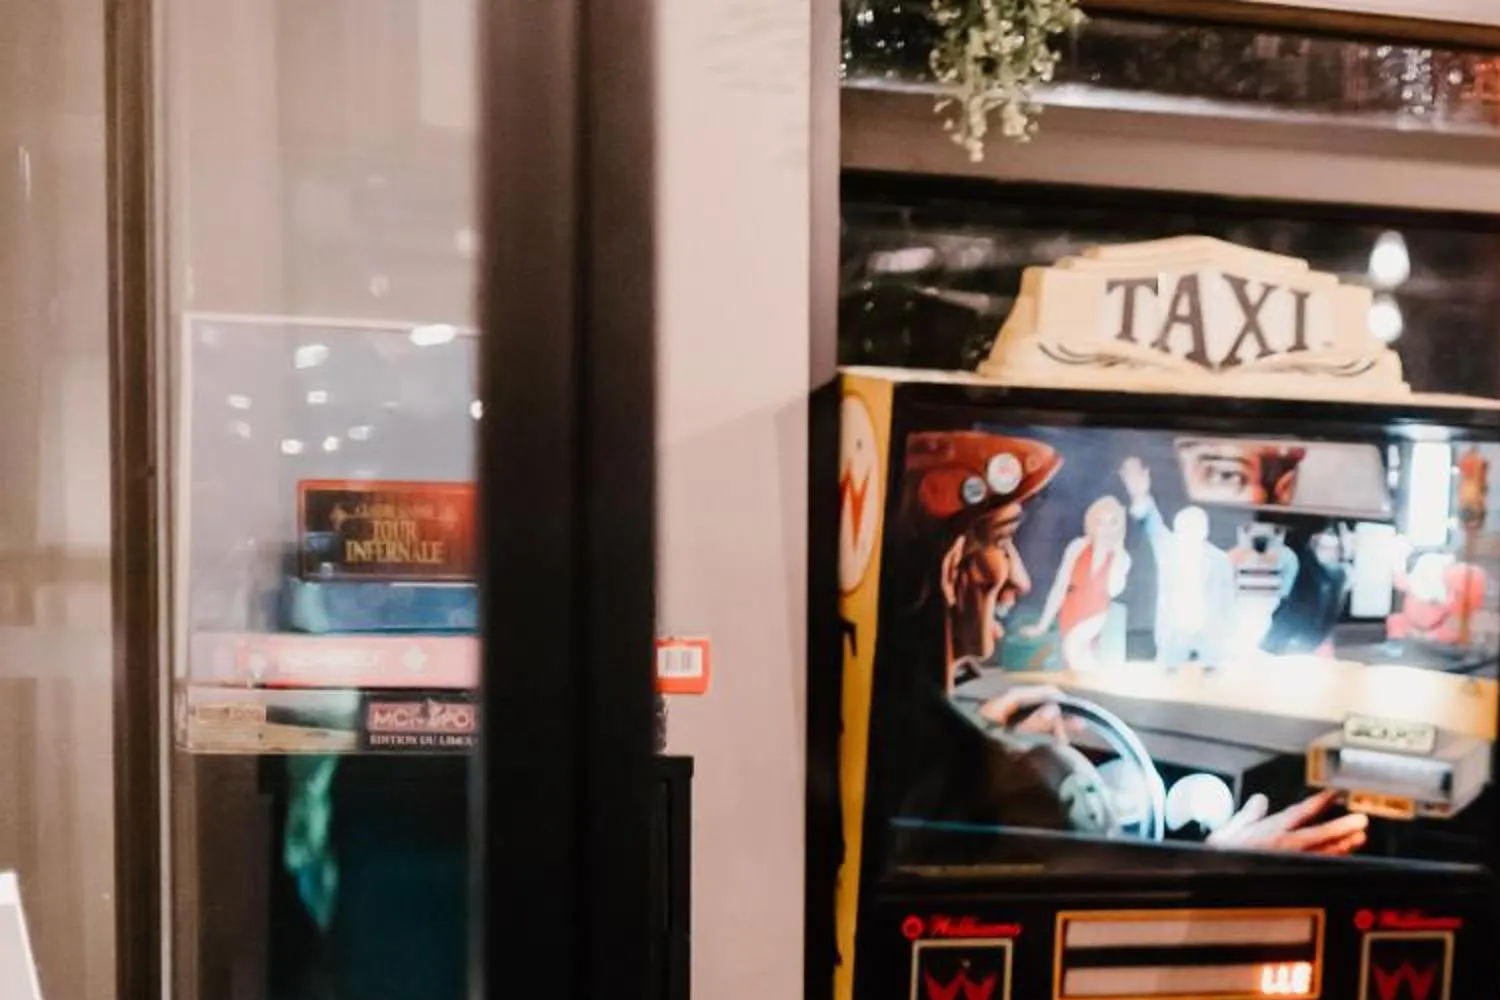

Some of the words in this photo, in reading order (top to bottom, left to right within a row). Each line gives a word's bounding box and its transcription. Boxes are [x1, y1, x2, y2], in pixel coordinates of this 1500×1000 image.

[1106, 272, 1311, 369] TAXI
[372, 519, 418, 544] TOUR
[345, 540, 443, 563] INFERNALE
